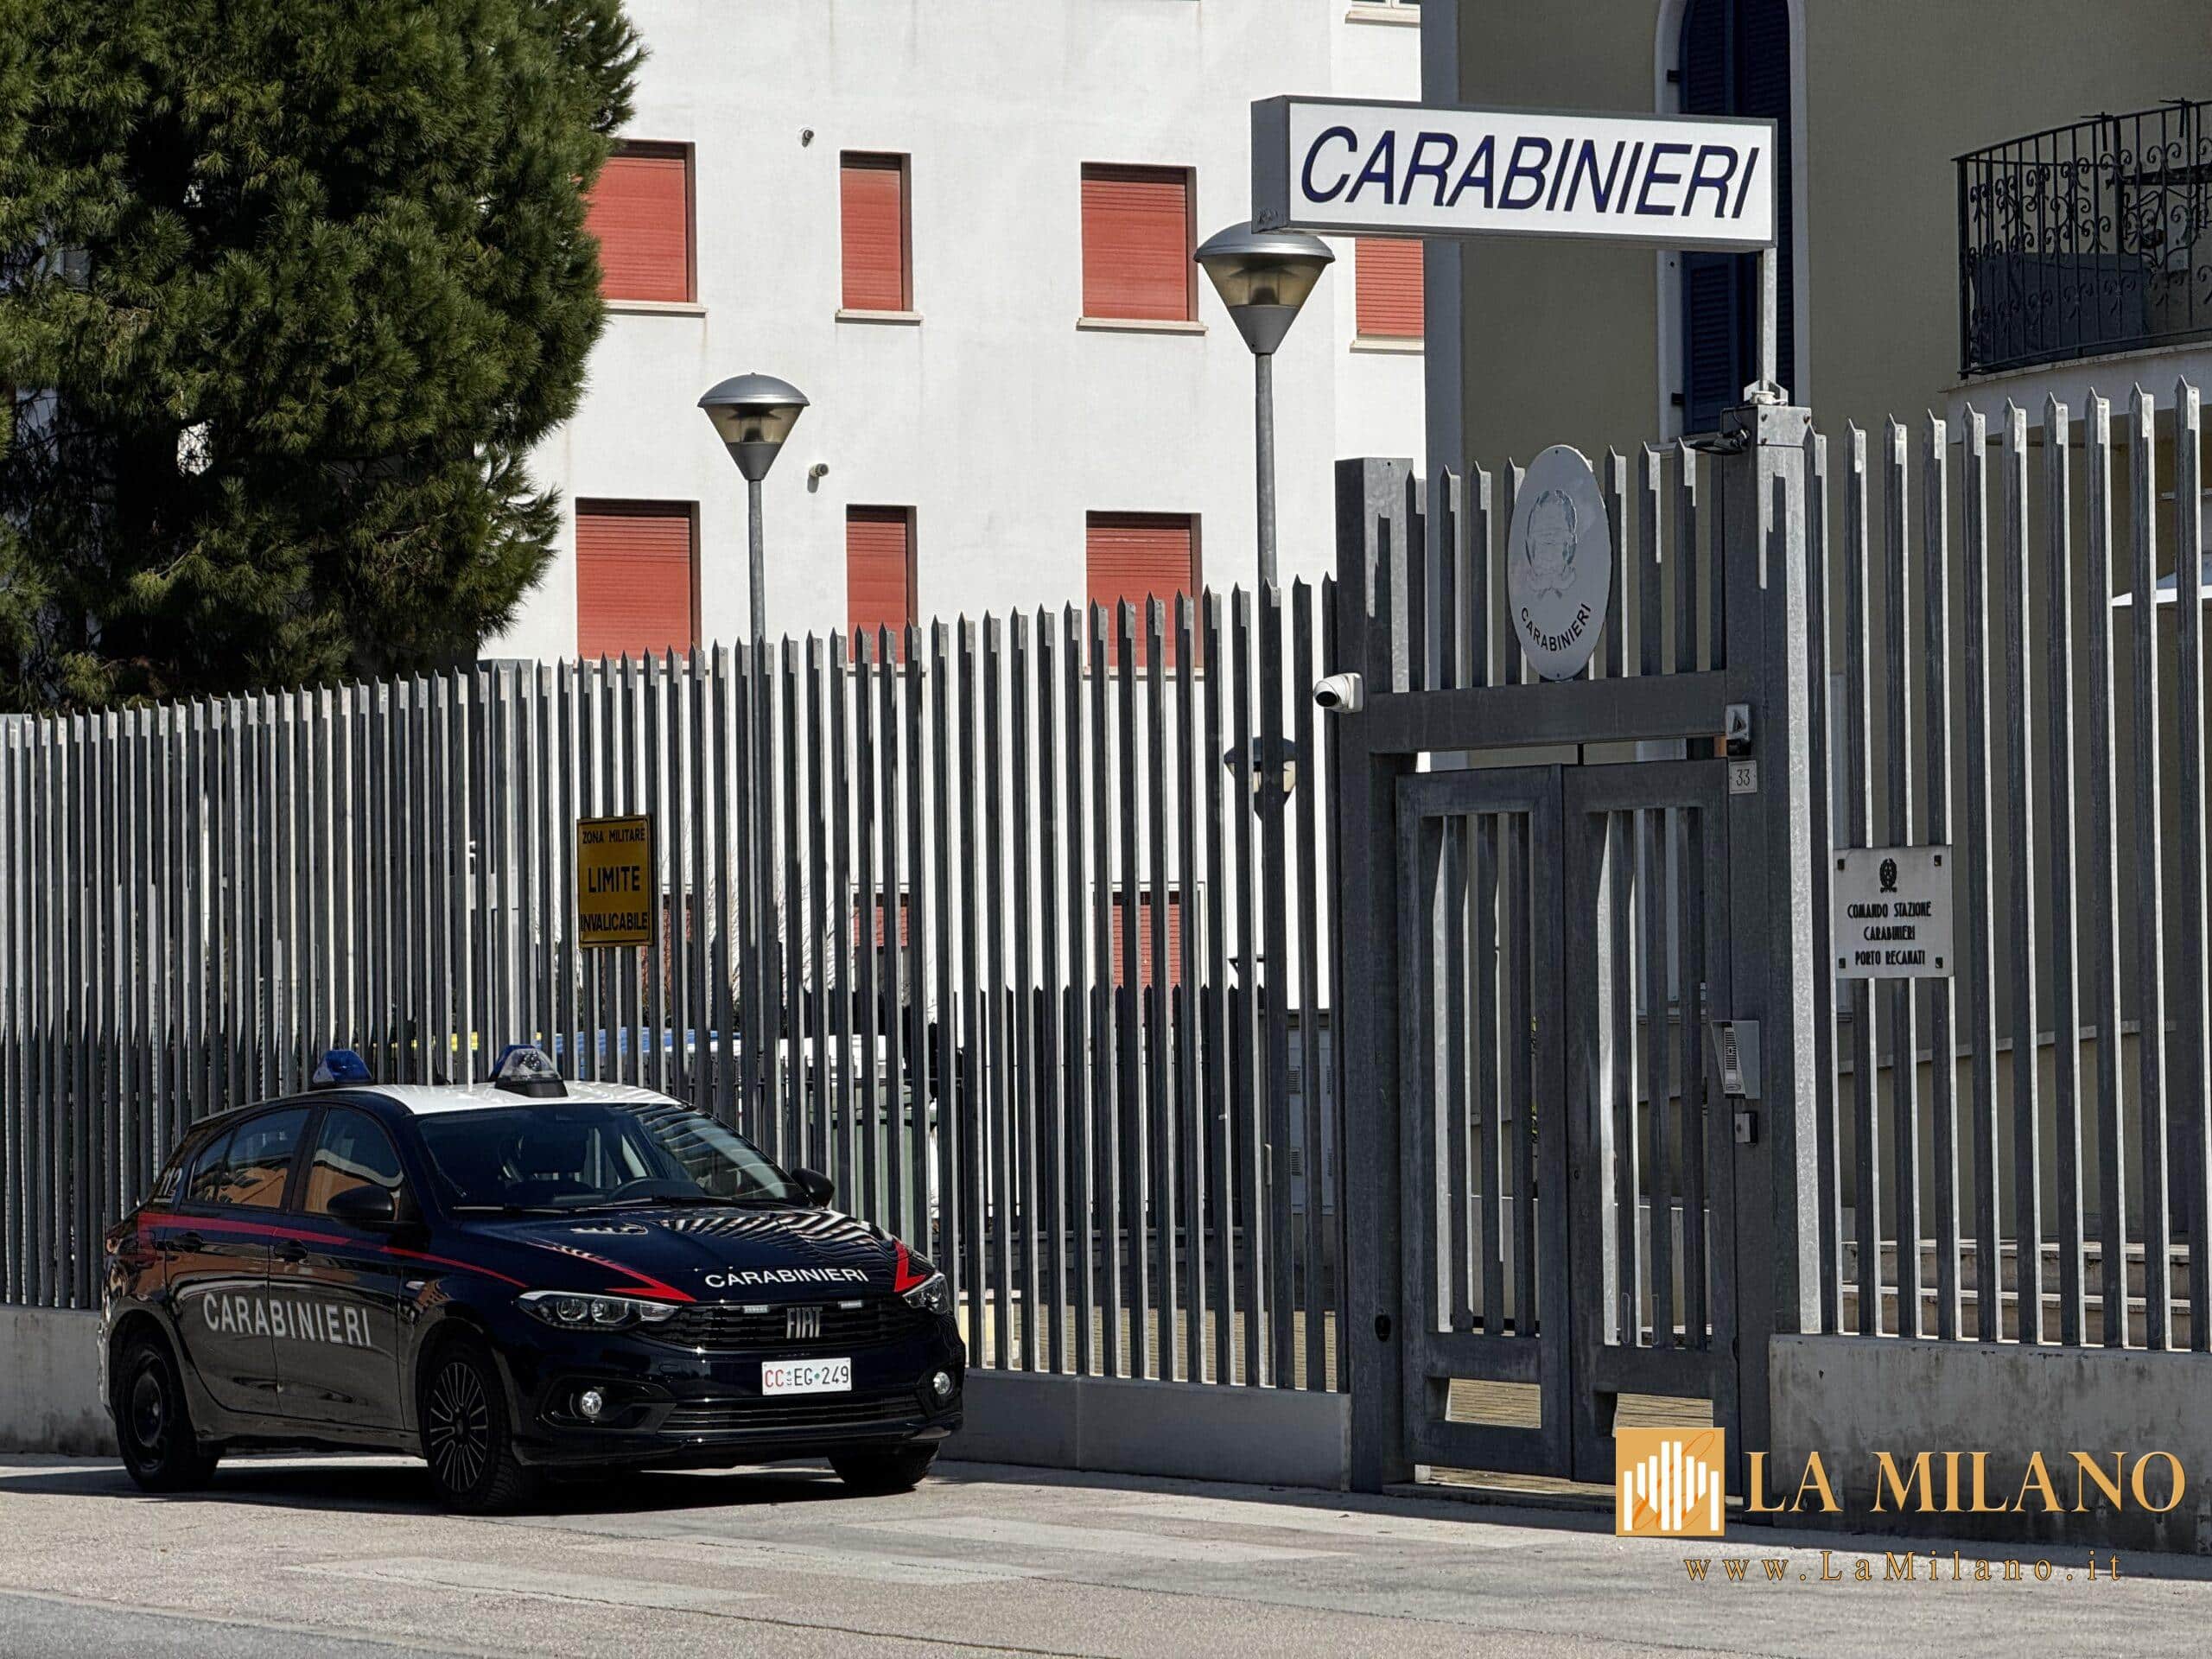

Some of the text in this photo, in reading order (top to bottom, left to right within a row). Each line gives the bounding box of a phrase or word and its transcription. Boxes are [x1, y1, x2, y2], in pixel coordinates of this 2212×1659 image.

[1300, 125, 1759, 219] CARABINIERI
[1521, 603, 1592, 652] CARABINIERI
[1736, 768, 1751, 786] 33
[582, 828, 645, 844] ZONA MILITARE
[588, 865, 640, 893] LIMITE
[1847, 901, 1932, 918] COMANDO STAZIONE
[581, 912, 647, 931] INVALICABILE
[1863, 925, 1916, 941] CARABINIERI
[1855, 950, 1925, 965] PORTO RECANATI
[705, 1268, 870, 1288] CARABINIERI
[202, 1292, 372, 1347] CARABINIERI
[786, 1306, 823, 1339] FIAT
